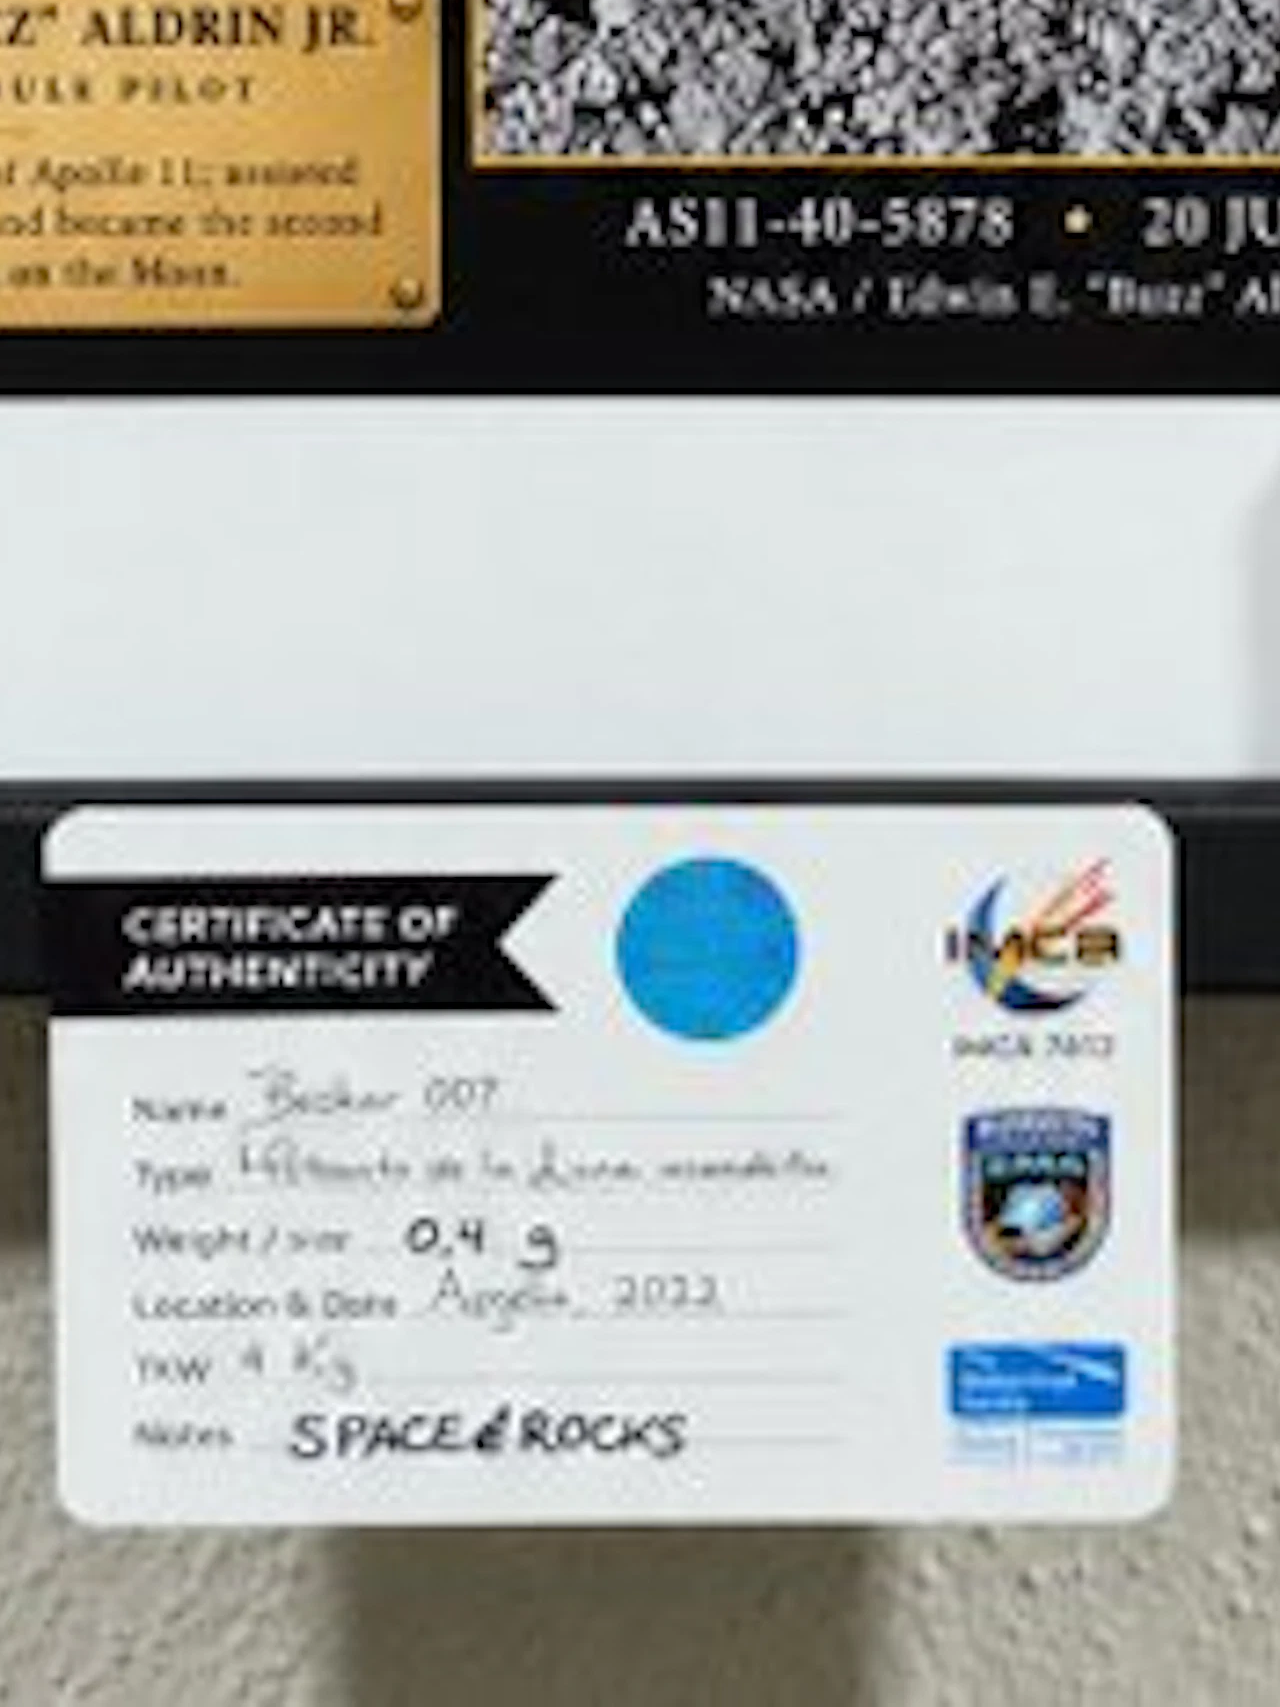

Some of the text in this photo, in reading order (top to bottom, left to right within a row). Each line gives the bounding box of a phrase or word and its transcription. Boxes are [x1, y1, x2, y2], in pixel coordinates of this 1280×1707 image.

[80, 6, 287, 47] ALDRIN
[300, 5, 376, 55] JR.
[120, 74, 258, 105] PILOT
[28, 157, 145, 195] Apollo
[54, 207, 186, 239] became
[198, 207, 255, 239] the
[264, 205, 384, 239] second
[624, 196, 1014, 248] AS11-40-5878
[1142, 196, 1208, 248] 20
[6, 259, 52, 289] on
[63, 255, 123, 289] the
[130, 255, 242, 289] Moon.
[707, 275, 837, 317] NASA
[851, 275, 872, 317] /
[886, 275, 1019, 317] Edwin
[1026, 275, 1072, 317] E.
[1084, 271, 1227, 317] "Buzz"
[121, 903, 458, 944] CERTIFICATE OF
[123, 948, 434, 989] AUTHENTICITY
[132, 1095, 228, 1123] Name
[132, 1157, 214, 1195] Type
[132, 1225, 250, 1259] Weight
[516, 1222, 560, 1273] g
[132, 1291, 400, 1321] Location & Date
[136, 1352, 213, 1384] TKW
[133, 1420, 234, 1451] Notes
